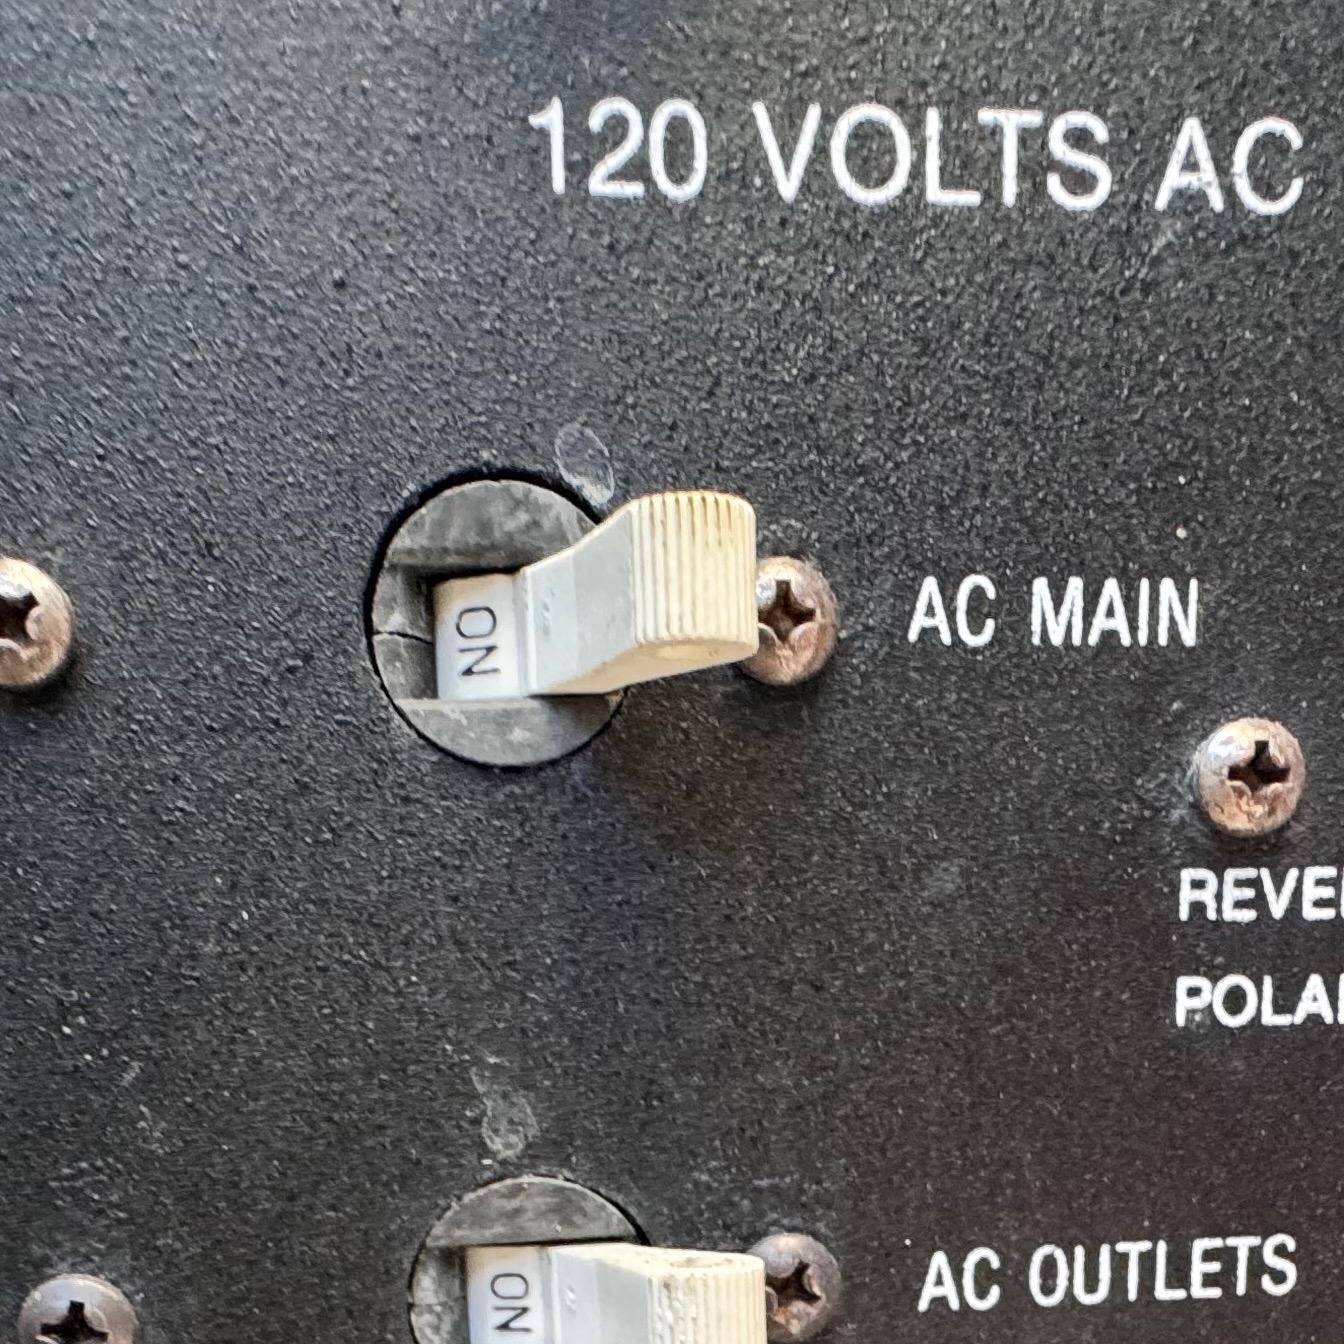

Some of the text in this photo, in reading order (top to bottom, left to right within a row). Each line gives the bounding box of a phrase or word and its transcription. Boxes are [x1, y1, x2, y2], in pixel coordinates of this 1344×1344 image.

[527, 94, 1305, 216] 120 VOLTS AC
[455, 605, 502, 677] ON
[907, 573, 1199, 649] AC MAIN
[489, 1272, 532, 1333] ON
[917, 1233, 1298, 1313] AC OUTLETS
